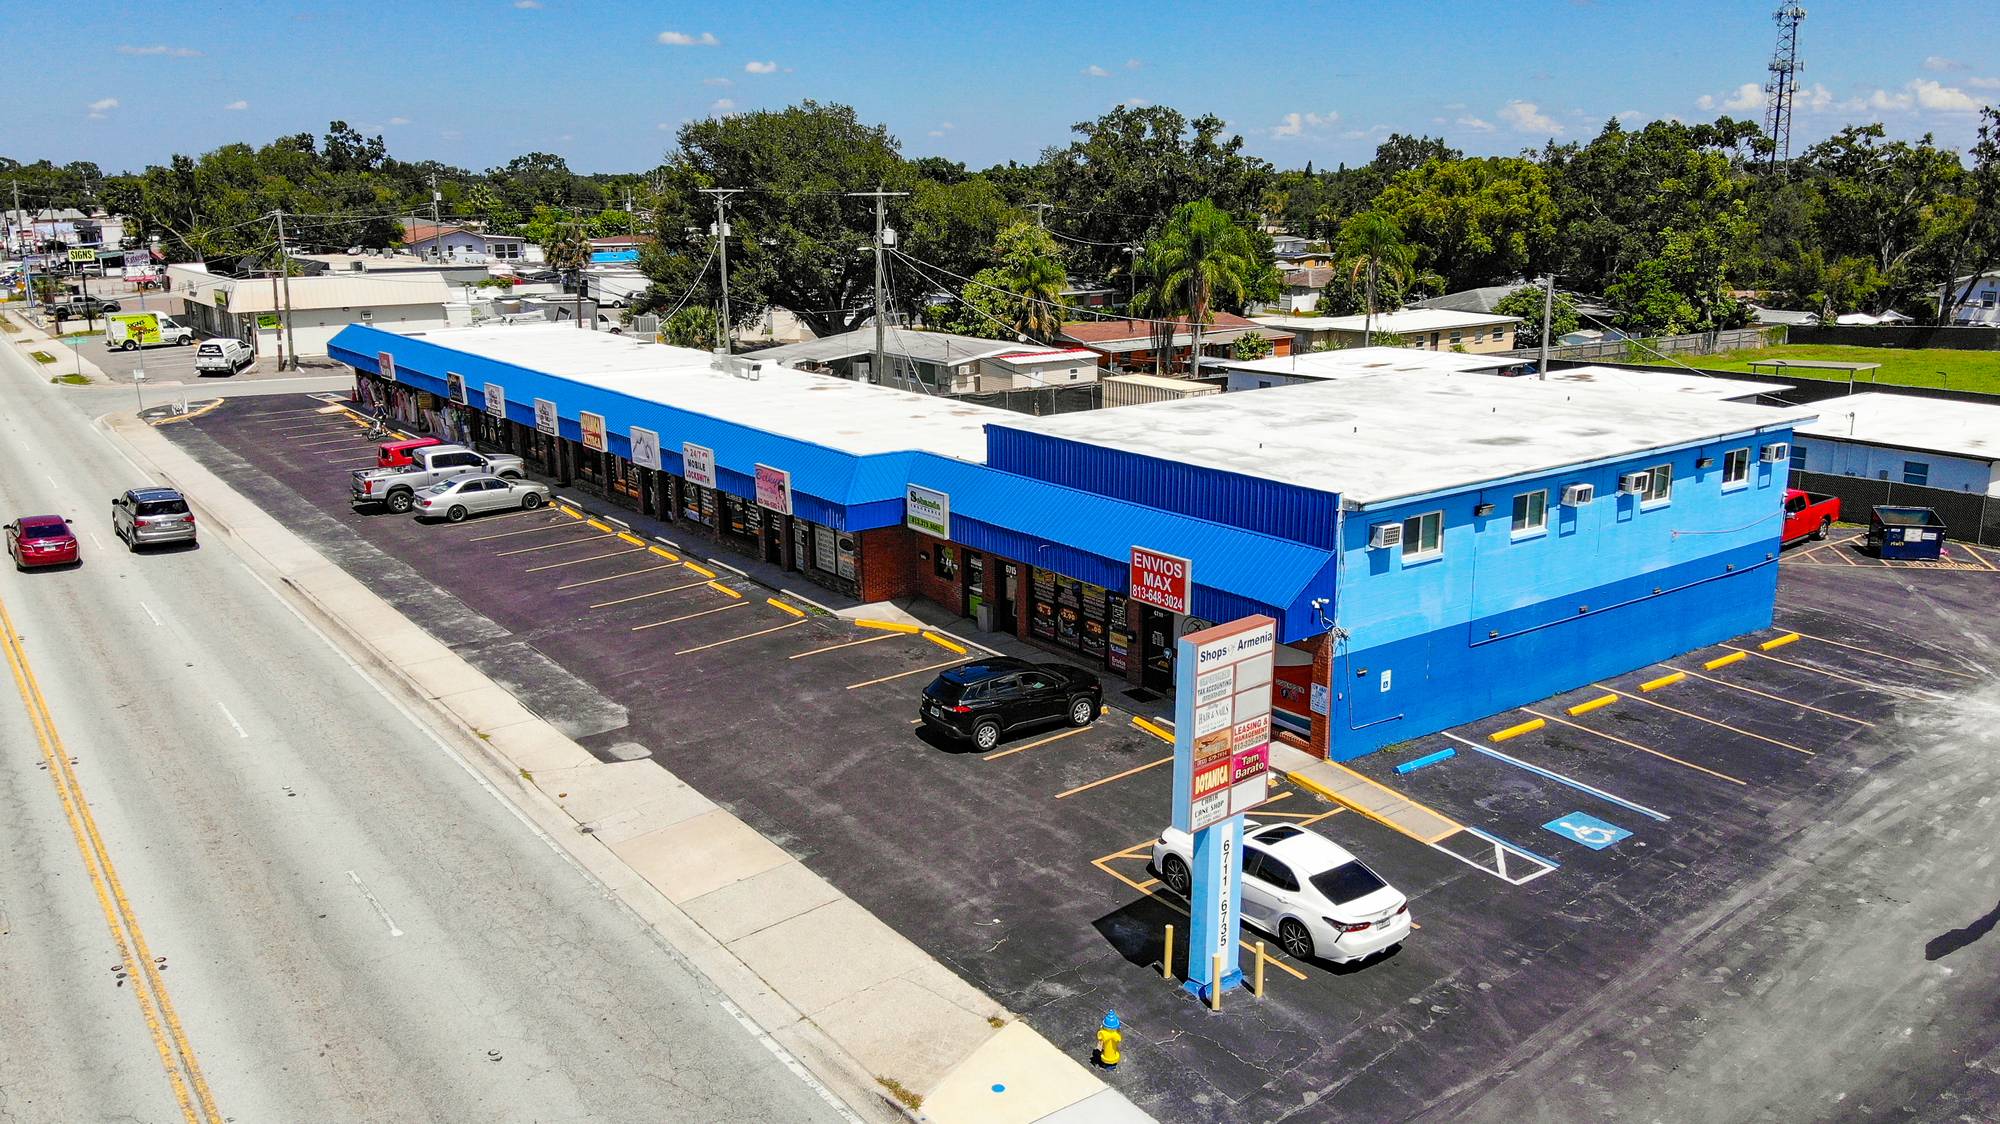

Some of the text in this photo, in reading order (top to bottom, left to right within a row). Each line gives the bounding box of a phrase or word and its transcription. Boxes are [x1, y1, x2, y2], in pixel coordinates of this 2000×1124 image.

[70, 250, 93, 260] SIGNS
[687, 458, 706, 472] MOBILE
[685, 468, 710, 484] LOCKSMITH
[1134, 552, 1183, 578] ENVIOS
[1143, 571, 1172, 592] MAX
[1132, 584, 1183, 610] 813-648-3024
[1200, 646, 1227, 663] Shops
[1237, 631, 1273, 651] Armenia
[1234, 719, 1264, 736] LEASING
[1263, 717, 1268, 726] &
[1234, 726, 1268, 742] MANAGEMENT
[1241, 753, 1260, 766] Tam
[1235, 762, 1265, 779] Barato
[1194, 765, 1229, 795] BOTANICA
